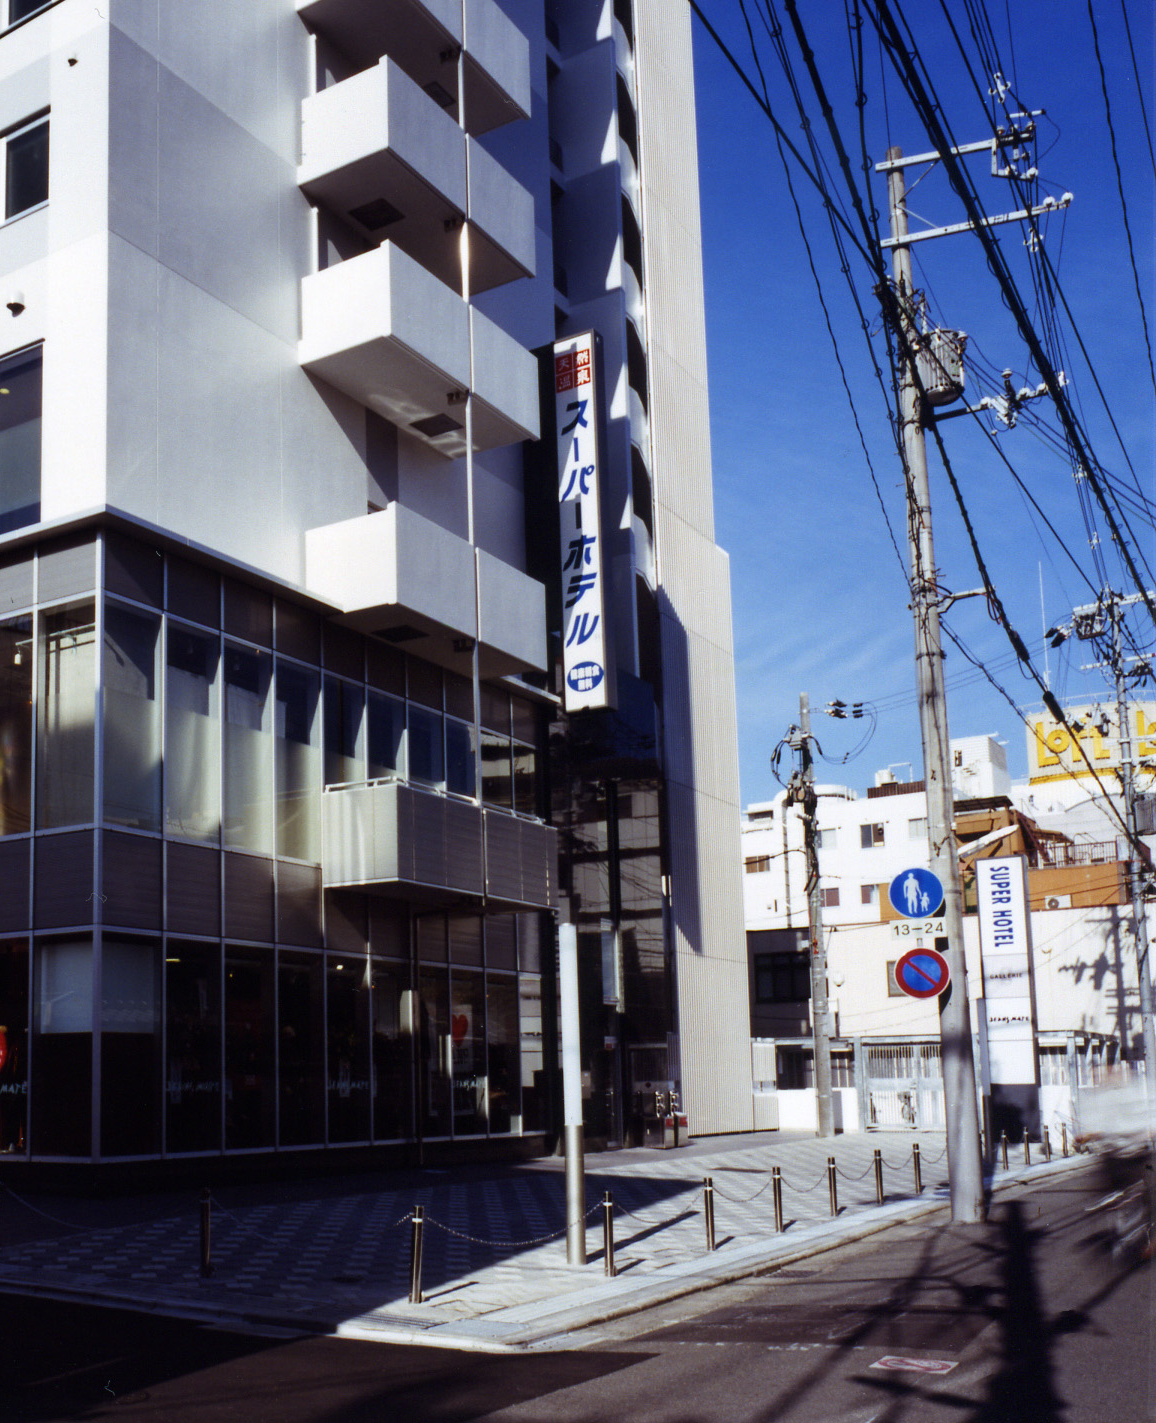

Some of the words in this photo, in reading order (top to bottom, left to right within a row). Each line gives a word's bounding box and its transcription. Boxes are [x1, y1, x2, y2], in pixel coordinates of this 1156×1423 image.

[561, 399, 600, 648] スーパーホテル
[990, 866, 1011, 904] SUPER
[993, 910, 1014, 947] HOTEL
